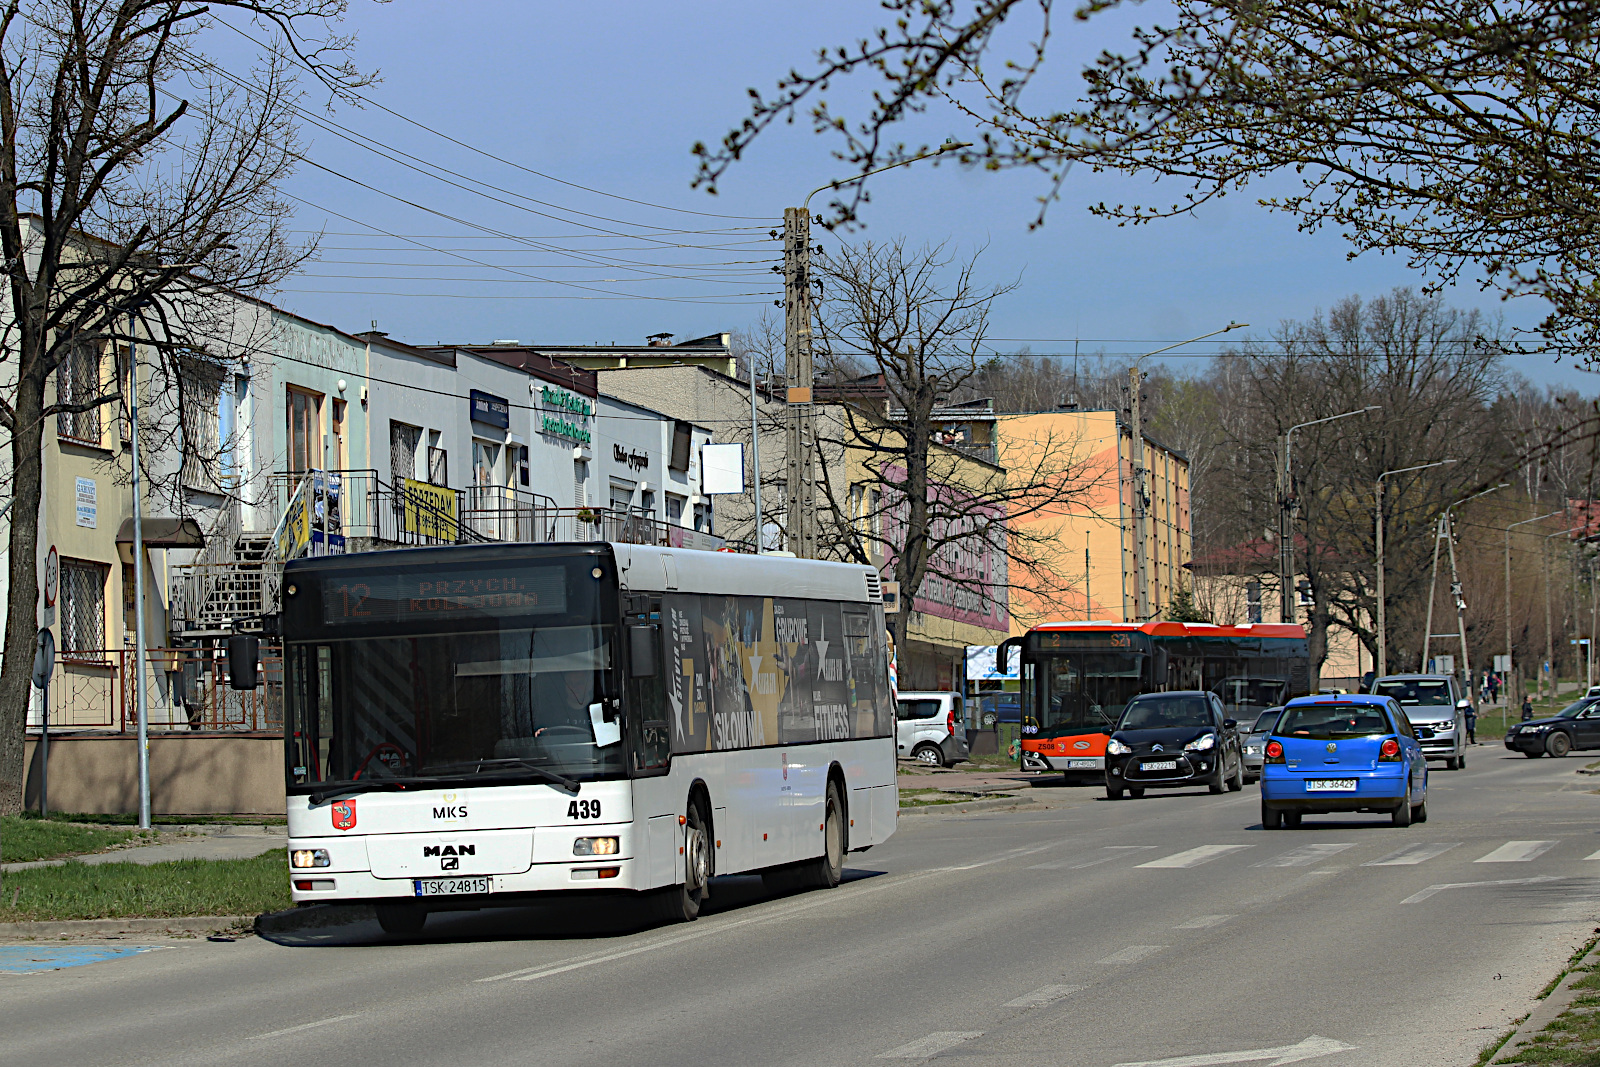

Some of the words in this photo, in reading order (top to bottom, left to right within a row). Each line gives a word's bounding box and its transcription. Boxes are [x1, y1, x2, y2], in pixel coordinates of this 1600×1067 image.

[408, 486, 452, 516] SPRZEDAM
[337, 583, 371, 616] 12
[776, 617, 808, 645] GRUPOWE
[1052, 633, 1060, 647] 2
[674, 646, 682, 700] SILVER
[714, 710, 766, 750] SIŁOWNIA
[814, 704, 850, 741] FITNESS
[1312, 780, 1327, 789] TSK
[1329, 779, 1354, 789] 36429
[433, 806, 468, 819] MKS
[567, 799, 601, 820] 439
[424, 844, 476, 858] MAN
[422, 881, 445, 894] TSK
[449, 879, 486, 893] 24815
